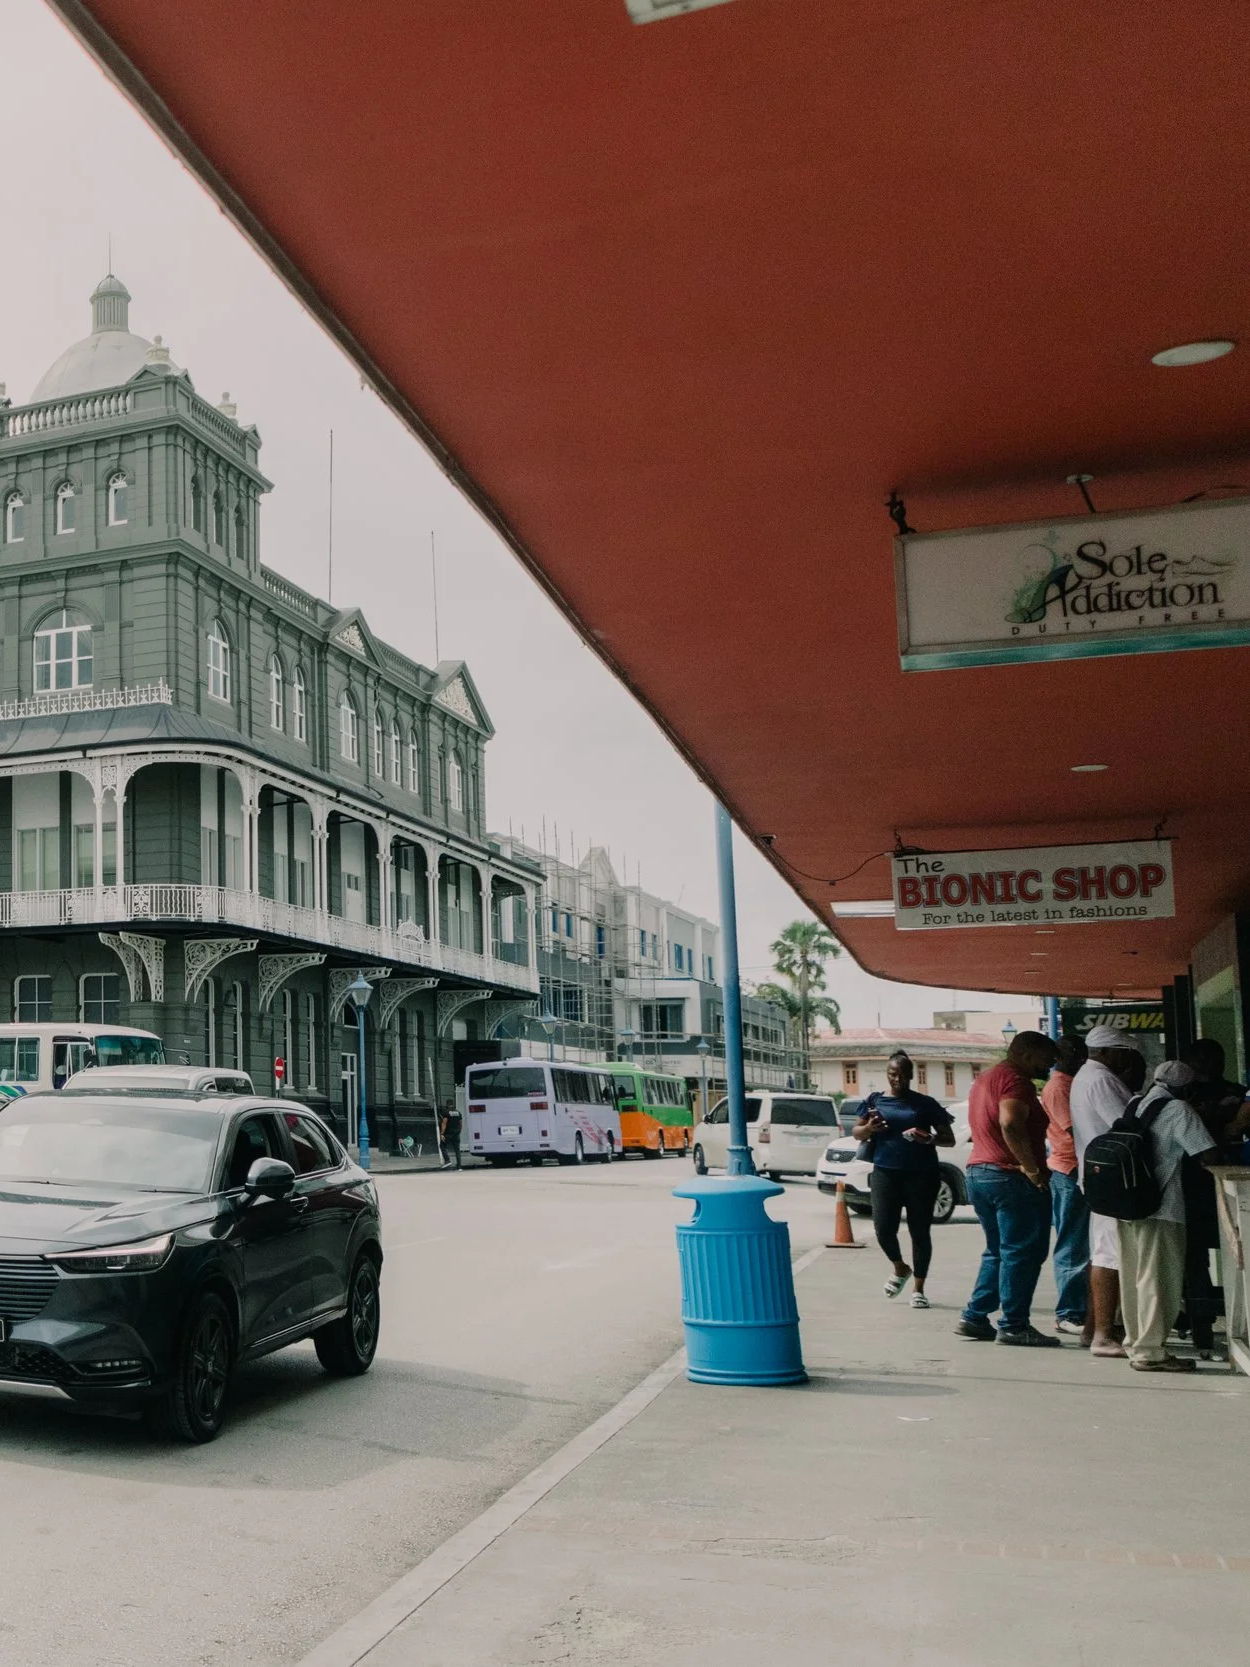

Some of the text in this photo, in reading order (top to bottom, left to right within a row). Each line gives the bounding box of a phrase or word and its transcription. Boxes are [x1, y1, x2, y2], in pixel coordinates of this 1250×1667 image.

[1075, 541, 1169, 580] Sole
[1025, 564, 1225, 622] Addiction
[1011, 608, 1226, 636] DUTY FREE
[898, 857, 946, 875] The
[897, 863, 1167, 910] BIONIC SHOP
[922, 904, 1148, 925] For the latest in fashions
[1074, 1012, 1165, 1031] SUBWA
